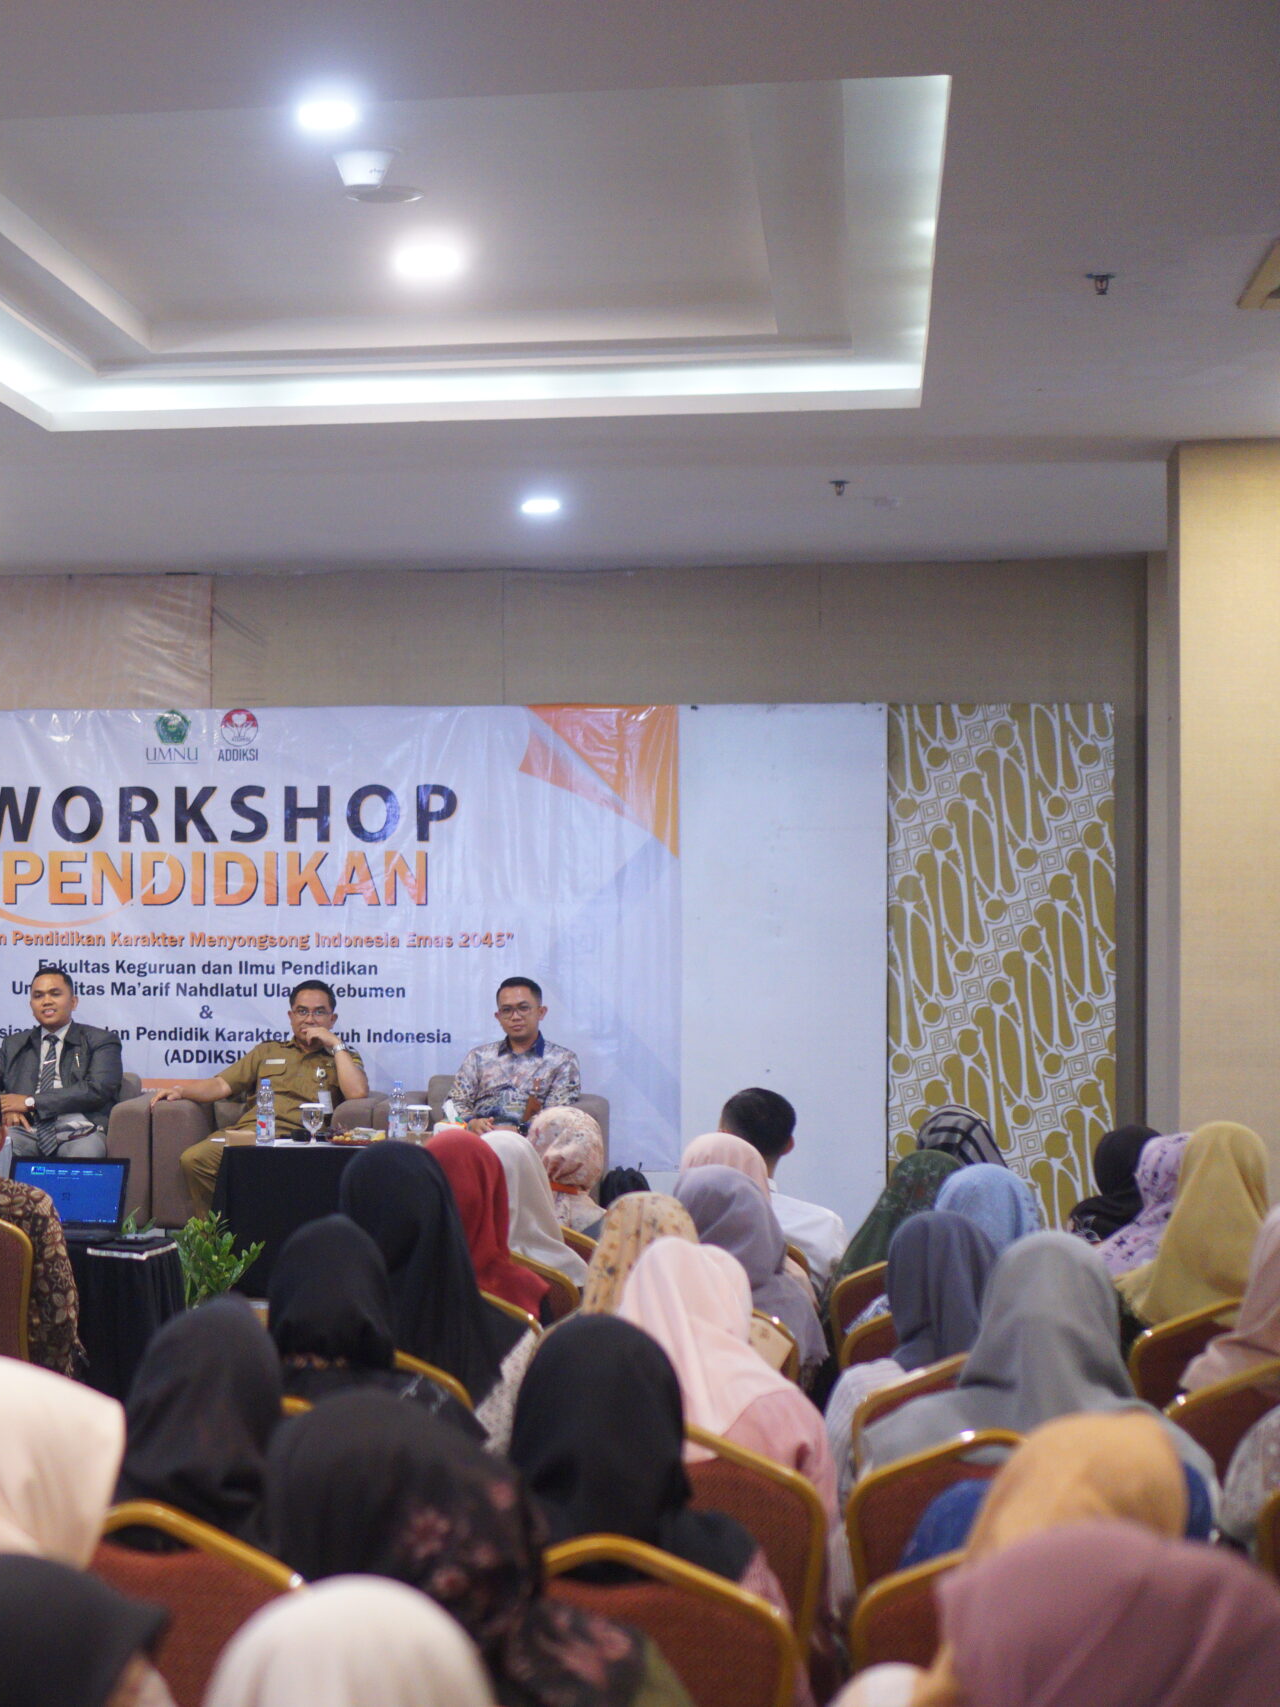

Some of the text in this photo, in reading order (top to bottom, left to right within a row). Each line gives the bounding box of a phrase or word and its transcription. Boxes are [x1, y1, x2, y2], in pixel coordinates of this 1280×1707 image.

[145, 747, 198, 761] UMNU
[217, 748, 259, 761] ADDIKSI
[2, 850, 428, 907] PENDIDIKAN
[11, 930, 106, 947] Pendidikan
[110, 931, 185, 947] Karakter
[189, 931, 311, 950] Menyongsong
[314, 931, 400, 948] Indonesia
[405, 932, 454, 948] Emas
[38, 959, 378, 978] Fakultas Keguruan dan Ilmu Pendidikan
[12, 981, 105, 996] Unitas
[111, 981, 171, 997] Ma'arif
[176, 982, 257, 997] Nahdlatul
[263, 983, 298, 998] Ula
[199, 1005, 213, 1019] &
[136, 1026, 210, 1042] Pendidik
[215, 1027, 290, 1042] Karakter
[367, 1028, 452, 1044] Indonesia
